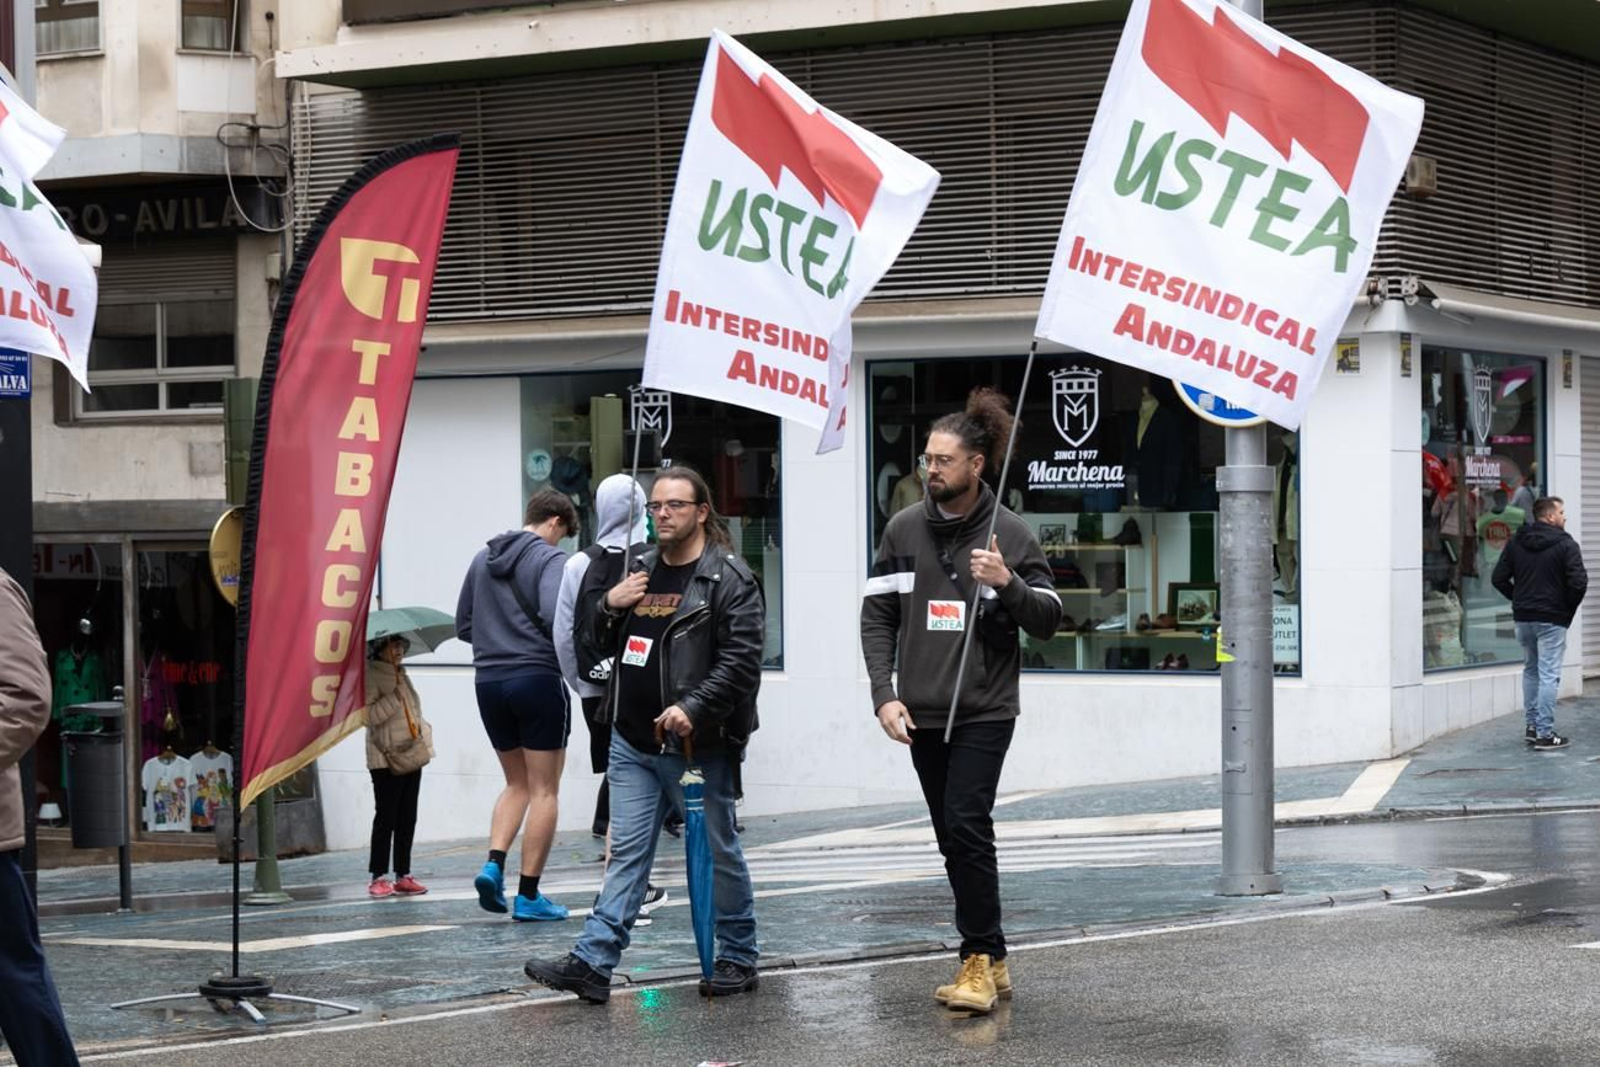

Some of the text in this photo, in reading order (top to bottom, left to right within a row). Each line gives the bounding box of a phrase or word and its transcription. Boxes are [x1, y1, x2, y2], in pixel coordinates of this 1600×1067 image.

[1113, 119, 1358, 273] USTEA
[664, 290, 829, 361] INTERSIND
[1068, 236, 1317, 355] INTERSINDICAL
[727, 350, 830, 409] ANDAL
[1113, 304, 1299, 401] ANDALUZA
[1027, 460, 1126, 483] Marchena
[1053, 449, 1098, 460] SINCE 1977
[309, 339, 390, 717] TABACOS
[931, 619, 963, 630] USTEA
[1273, 617, 1292, 625] ONA
